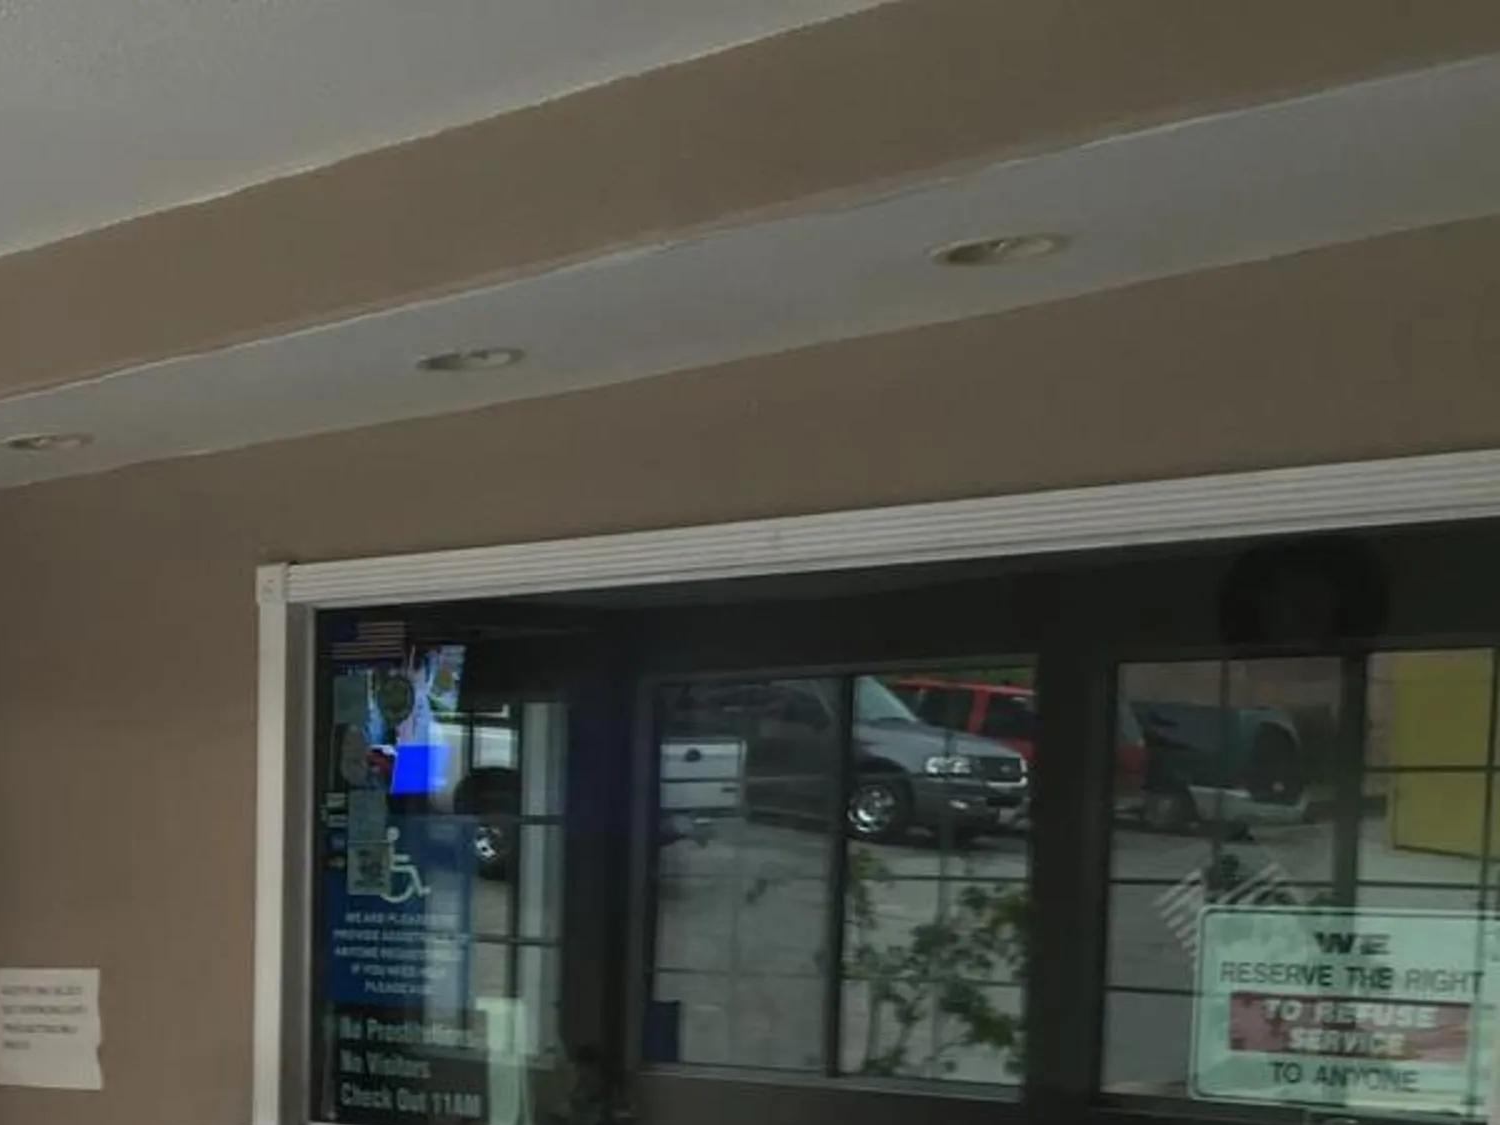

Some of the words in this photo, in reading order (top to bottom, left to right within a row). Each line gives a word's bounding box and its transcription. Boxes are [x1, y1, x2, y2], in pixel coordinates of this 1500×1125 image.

[1314, 932, 1391, 955] WE
[1219, 961, 1333, 987] RESERVE
[1346, 966, 1393, 990] THE
[1405, 968, 1485, 993] RIGHT
[1261, 999, 1302, 1021] TO
[1314, 1002, 1438, 1029] REFUSE
[1288, 1028, 1405, 1056] SERVICE
[1270, 1062, 1302, 1085] TO
[1313, 1066, 1419, 1093] ANYONE
[341, 1081, 392, 1109] Check
[397, 1086, 426, 1112] Out
